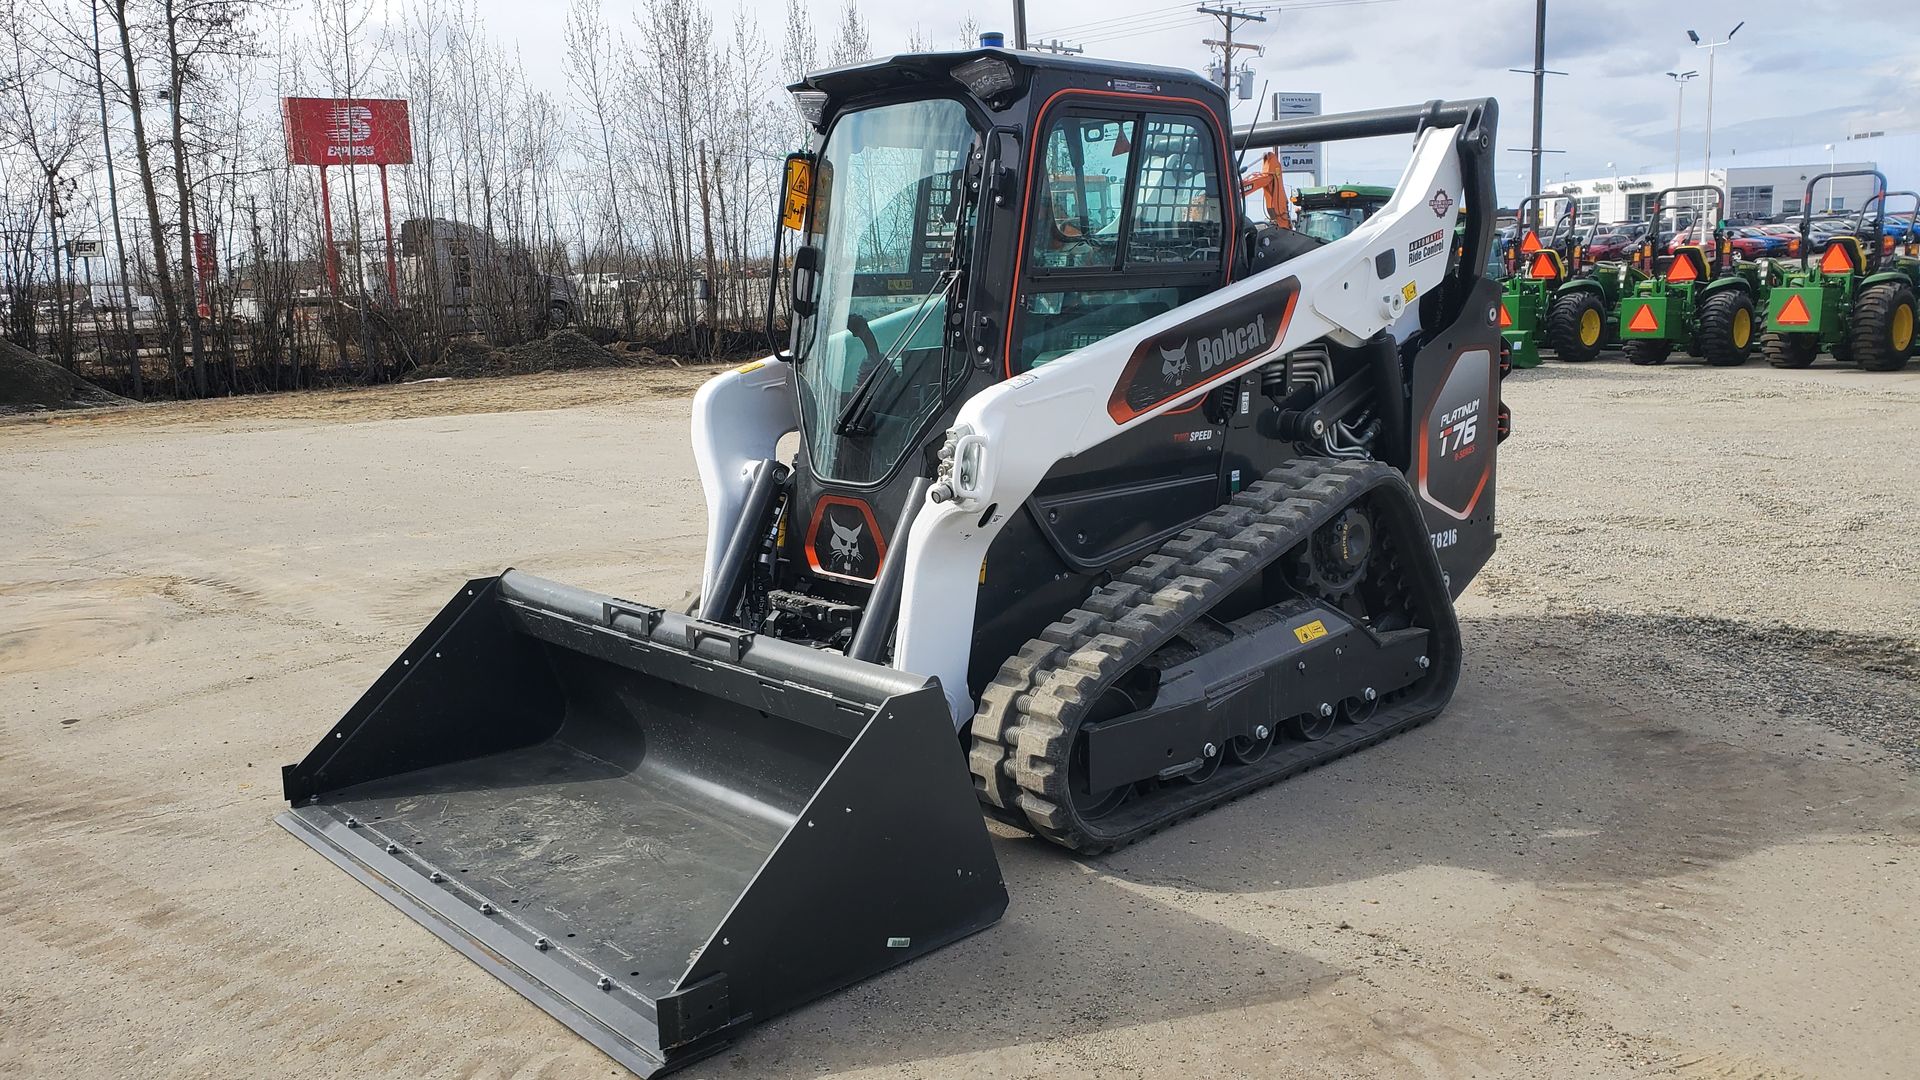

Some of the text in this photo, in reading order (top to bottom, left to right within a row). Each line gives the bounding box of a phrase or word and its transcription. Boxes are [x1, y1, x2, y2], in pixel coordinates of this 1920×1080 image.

[327, 146, 375, 157] EXPRESS
[1408, 239, 1444, 265] Ride Control
[1409, 230, 1444, 251] AUTOMATIC
[1197, 313, 1267, 373] Bobcat
[1440, 398, 1480, 428] PLATINUM
[1189, 429, 1213, 442] SPEED
[1439, 414, 1478, 458] T76
